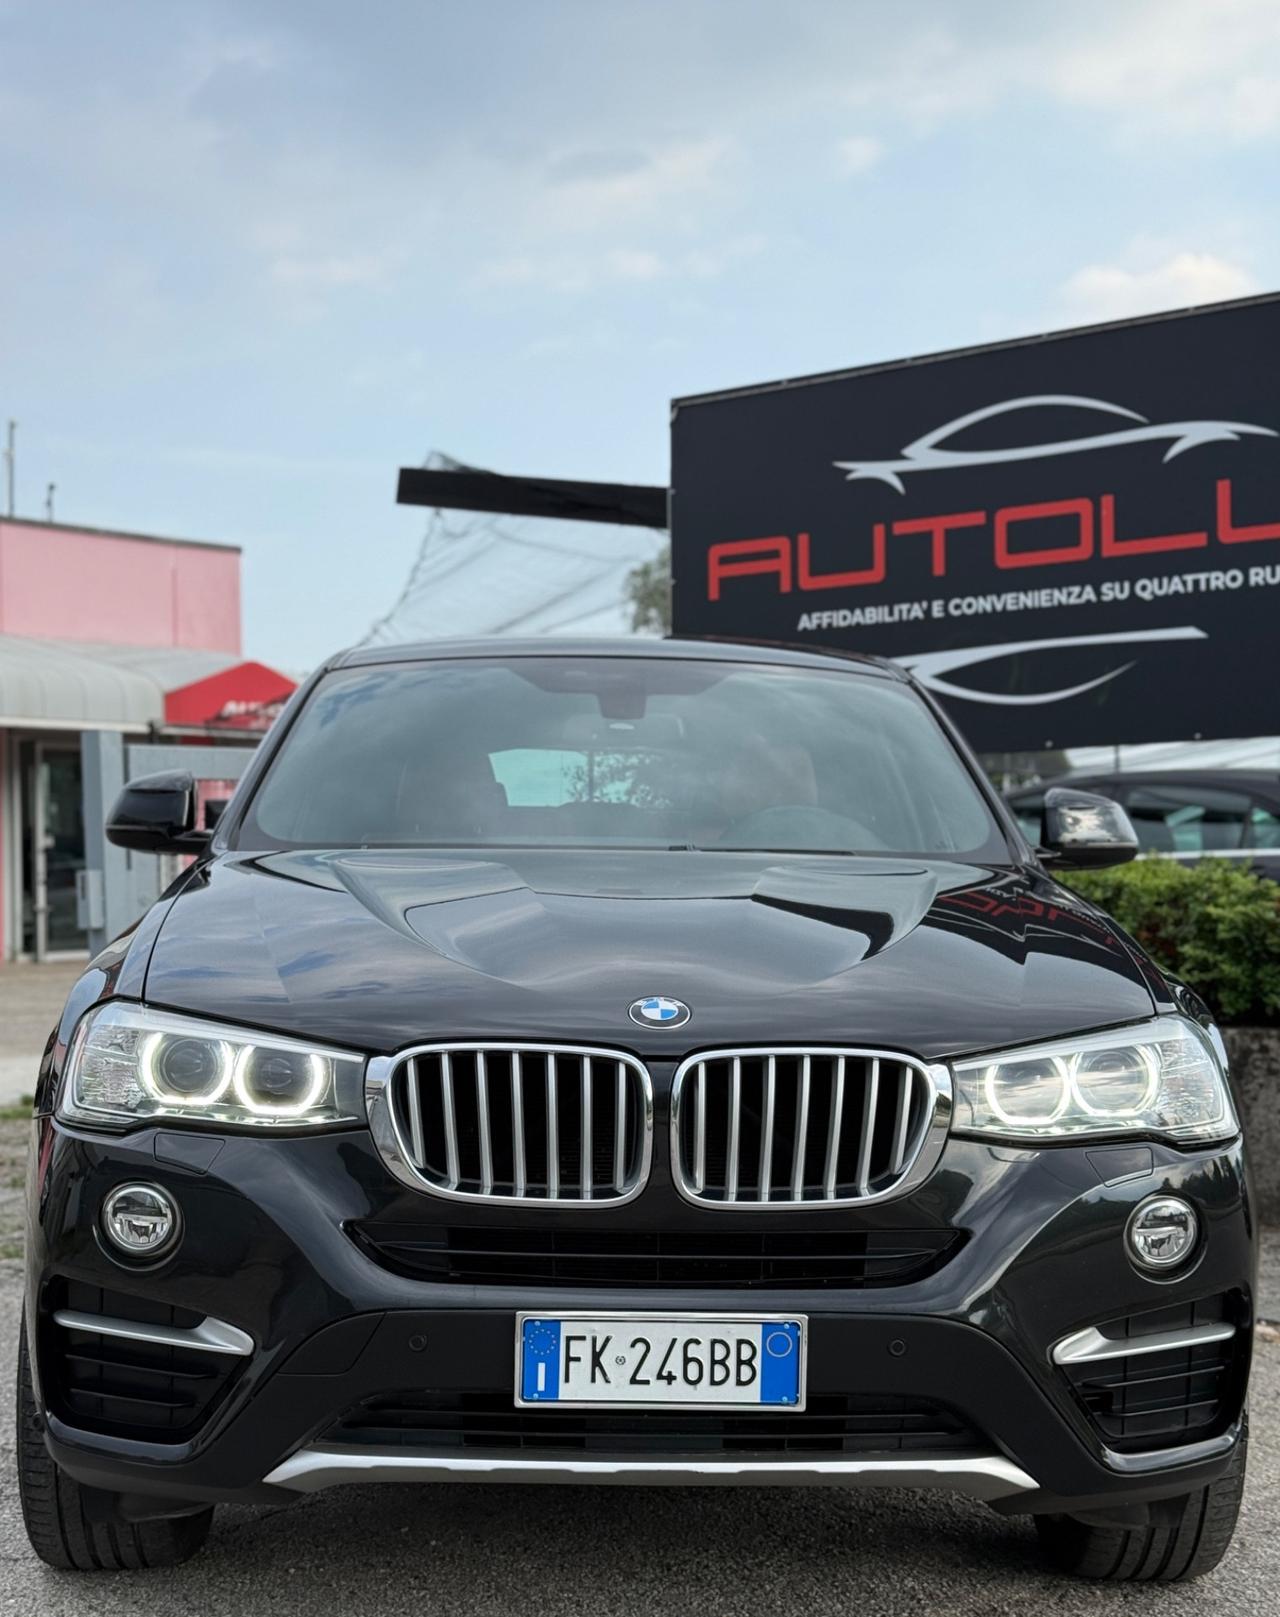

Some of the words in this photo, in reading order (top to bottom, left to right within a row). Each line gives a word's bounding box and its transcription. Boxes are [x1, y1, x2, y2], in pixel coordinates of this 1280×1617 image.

[797, 600, 928, 631] AFFIDABILITA'
[931, 599, 945, 618] E
[948, 584, 1097, 616] CONVENIENZA
[1100, 580, 1131, 601] SU
[1134, 568, 1245, 600] QUATTRO
